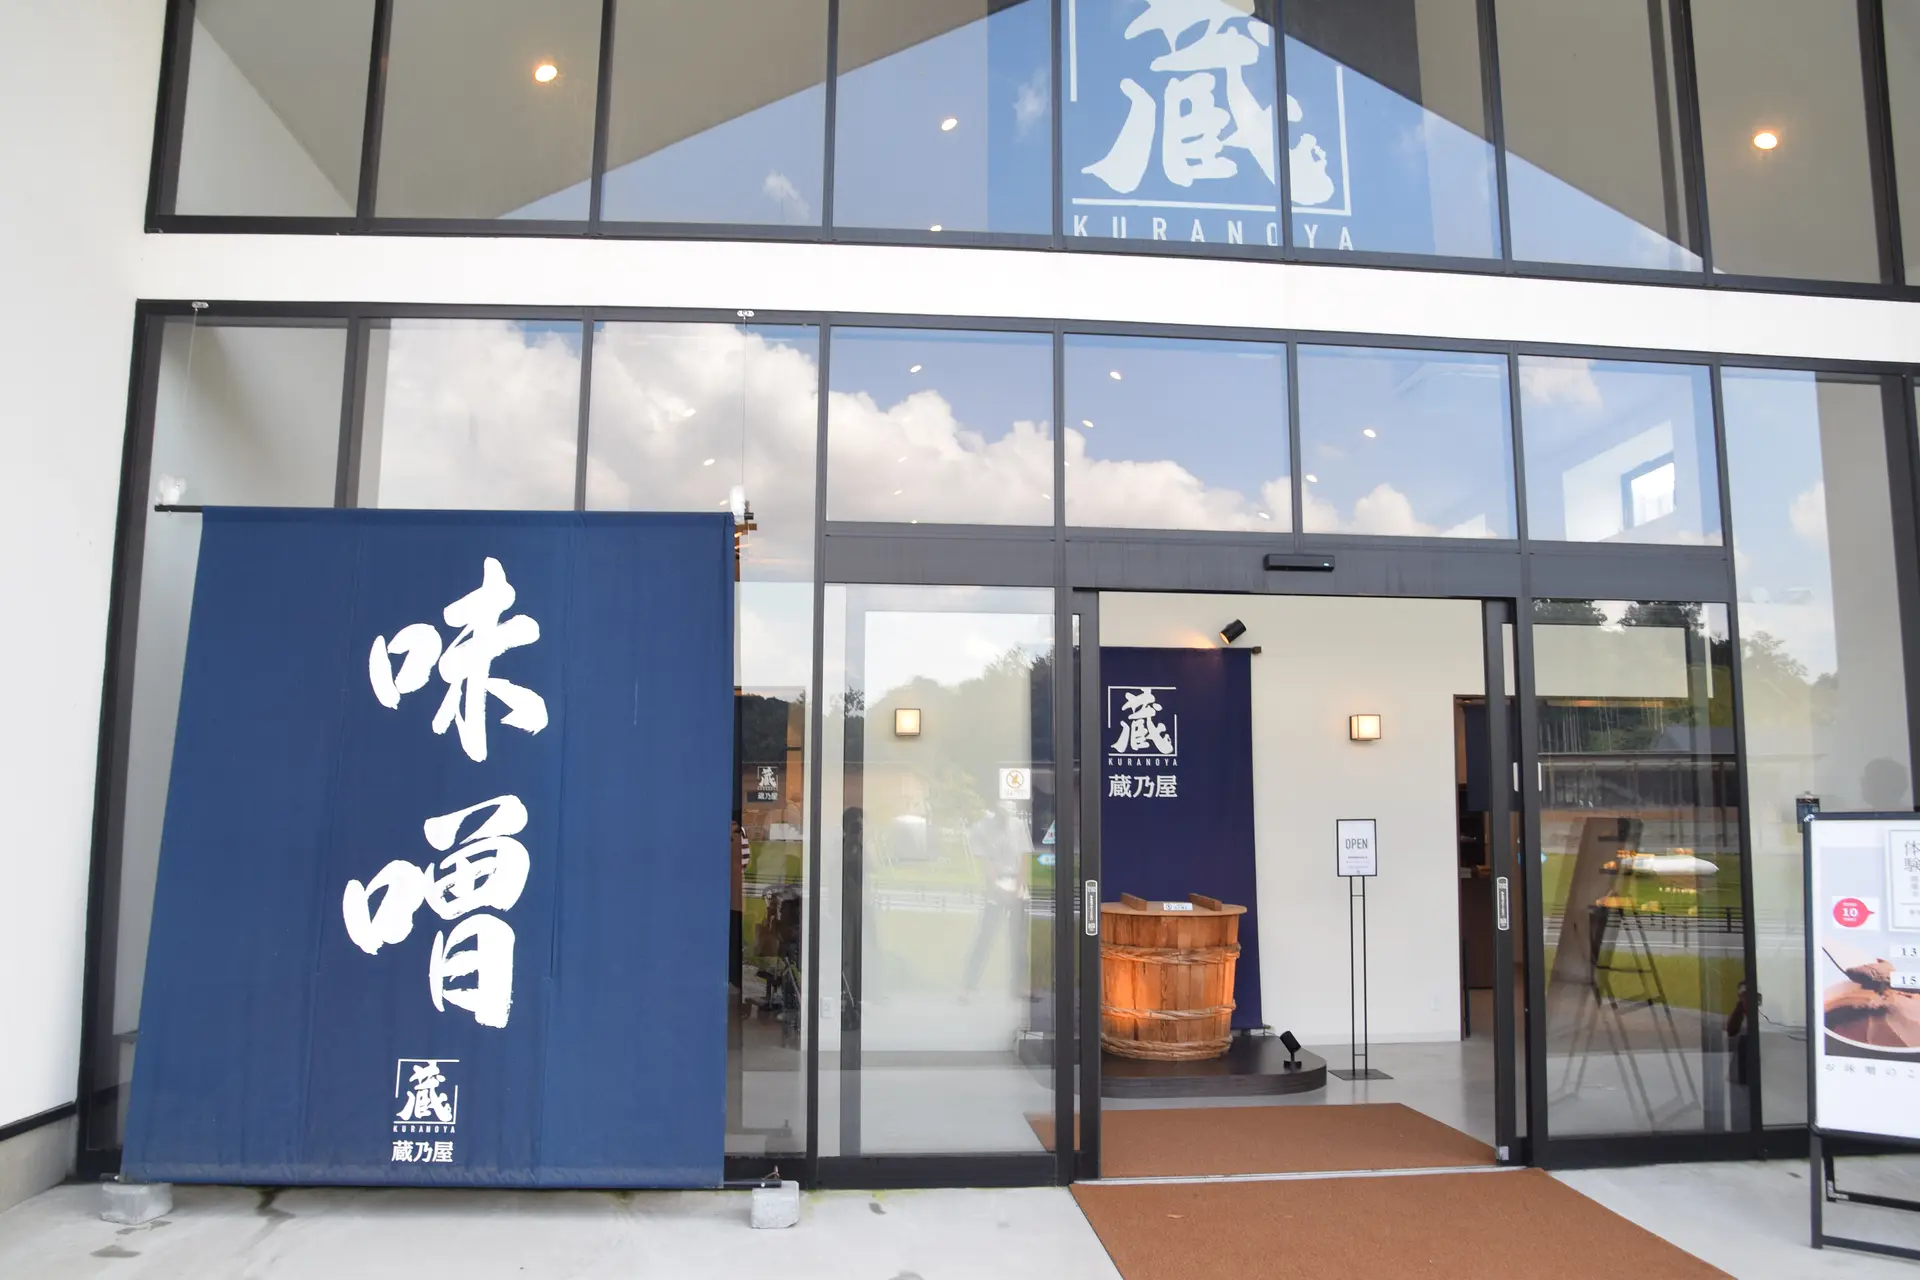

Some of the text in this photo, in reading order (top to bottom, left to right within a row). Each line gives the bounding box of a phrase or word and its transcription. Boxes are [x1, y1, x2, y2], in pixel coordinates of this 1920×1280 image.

[1073, 215, 1354, 251] KURANOYA
[1108, 758, 1178, 767] KURANOYA
[1108, 774, 1178, 798] 蔵乃屋
[1345, 838, 1368, 850] OPEN
[1842, 907, 1859, 918] 10
[393, 1125, 455, 1133] KURANOYA
[391, 1140, 454, 1162] 蔵乃屋
